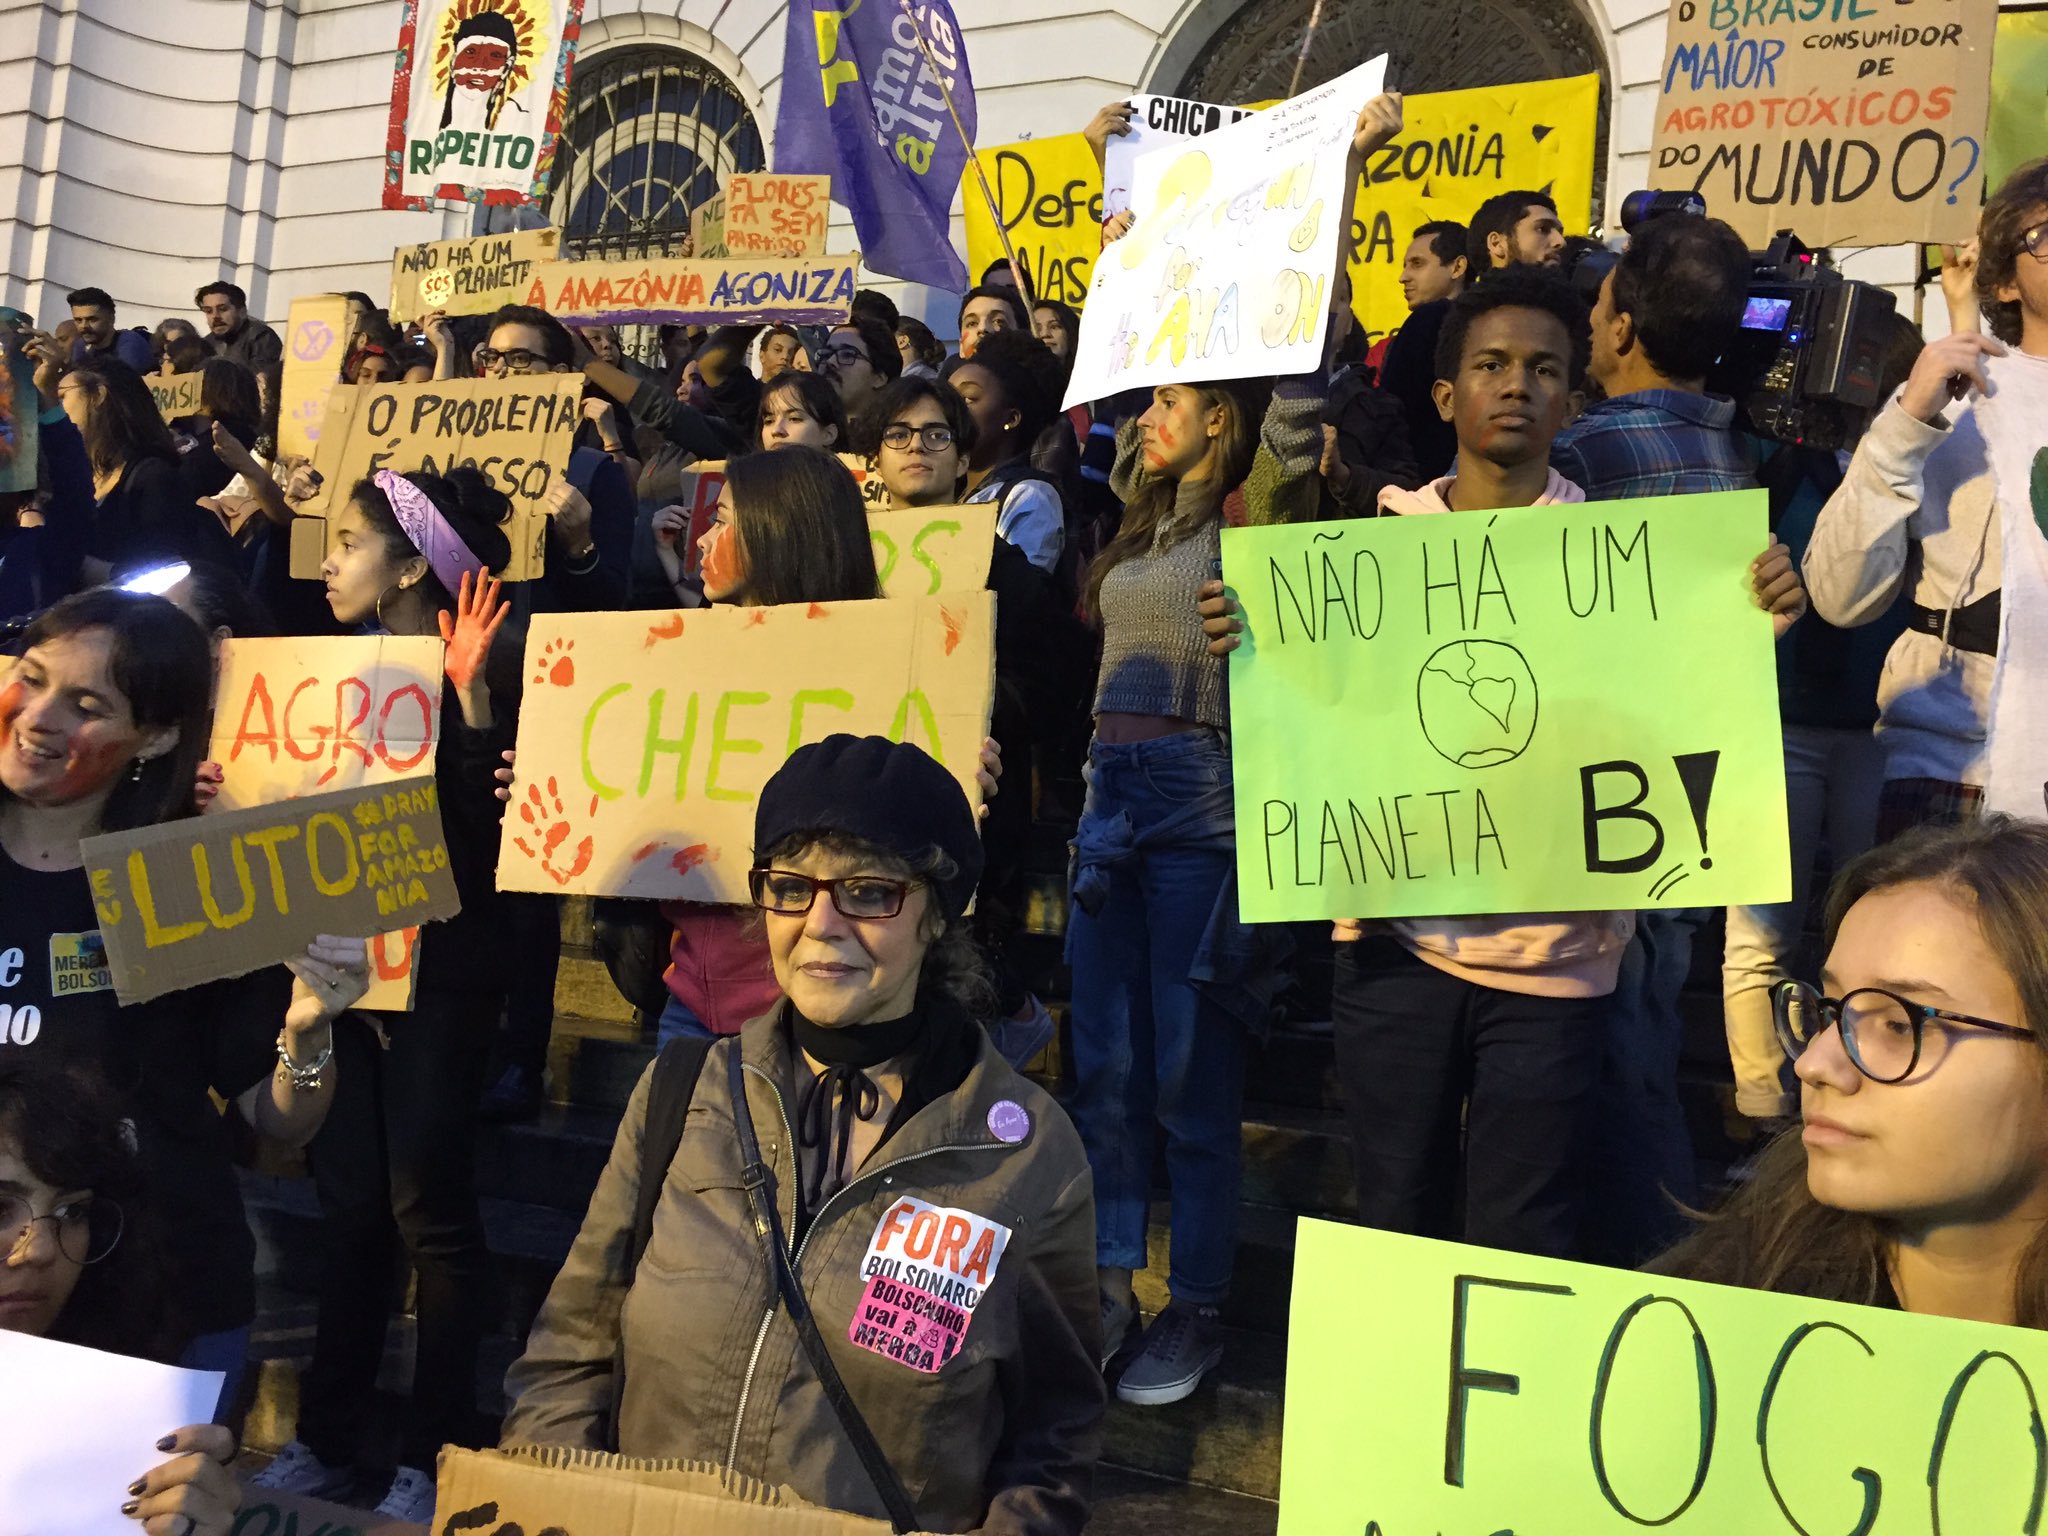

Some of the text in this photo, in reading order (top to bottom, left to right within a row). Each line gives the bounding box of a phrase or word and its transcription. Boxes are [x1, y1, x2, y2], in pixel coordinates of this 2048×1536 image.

[1678, 1, 1696, 23] O
[1803, 24, 1963, 51] CONSUMIDOR
[1857, 56, 1896, 79] DE
[1663, 86, 1958, 135] AGROTÓXICOS
[1658, 144, 1701, 169] DO
[729, 204, 759, 225] TA
[771, 208, 824, 237] SEM
[402, 239, 512, 274] NÃO HÁ UM
[526, 261, 855, 311] A AMAZÔNIA AGONIZA
[367, 394, 398, 438] O
[410, 393, 577, 438] PROBLEMA
[1270, 514, 1658, 645] NÃO HÁ UM
[229, 671, 433, 774] AGRO
[358, 823, 420, 862] FOR
[1263, 787, 1508, 890] PLANETA
[127, 812, 360, 949] LUTO
[376, 878, 430, 916] NIA
[875, 1203, 996, 1285] FORA
[864, 1304, 900, 1329] vai
[1444, 1274, 2048, 1536] FOGO
